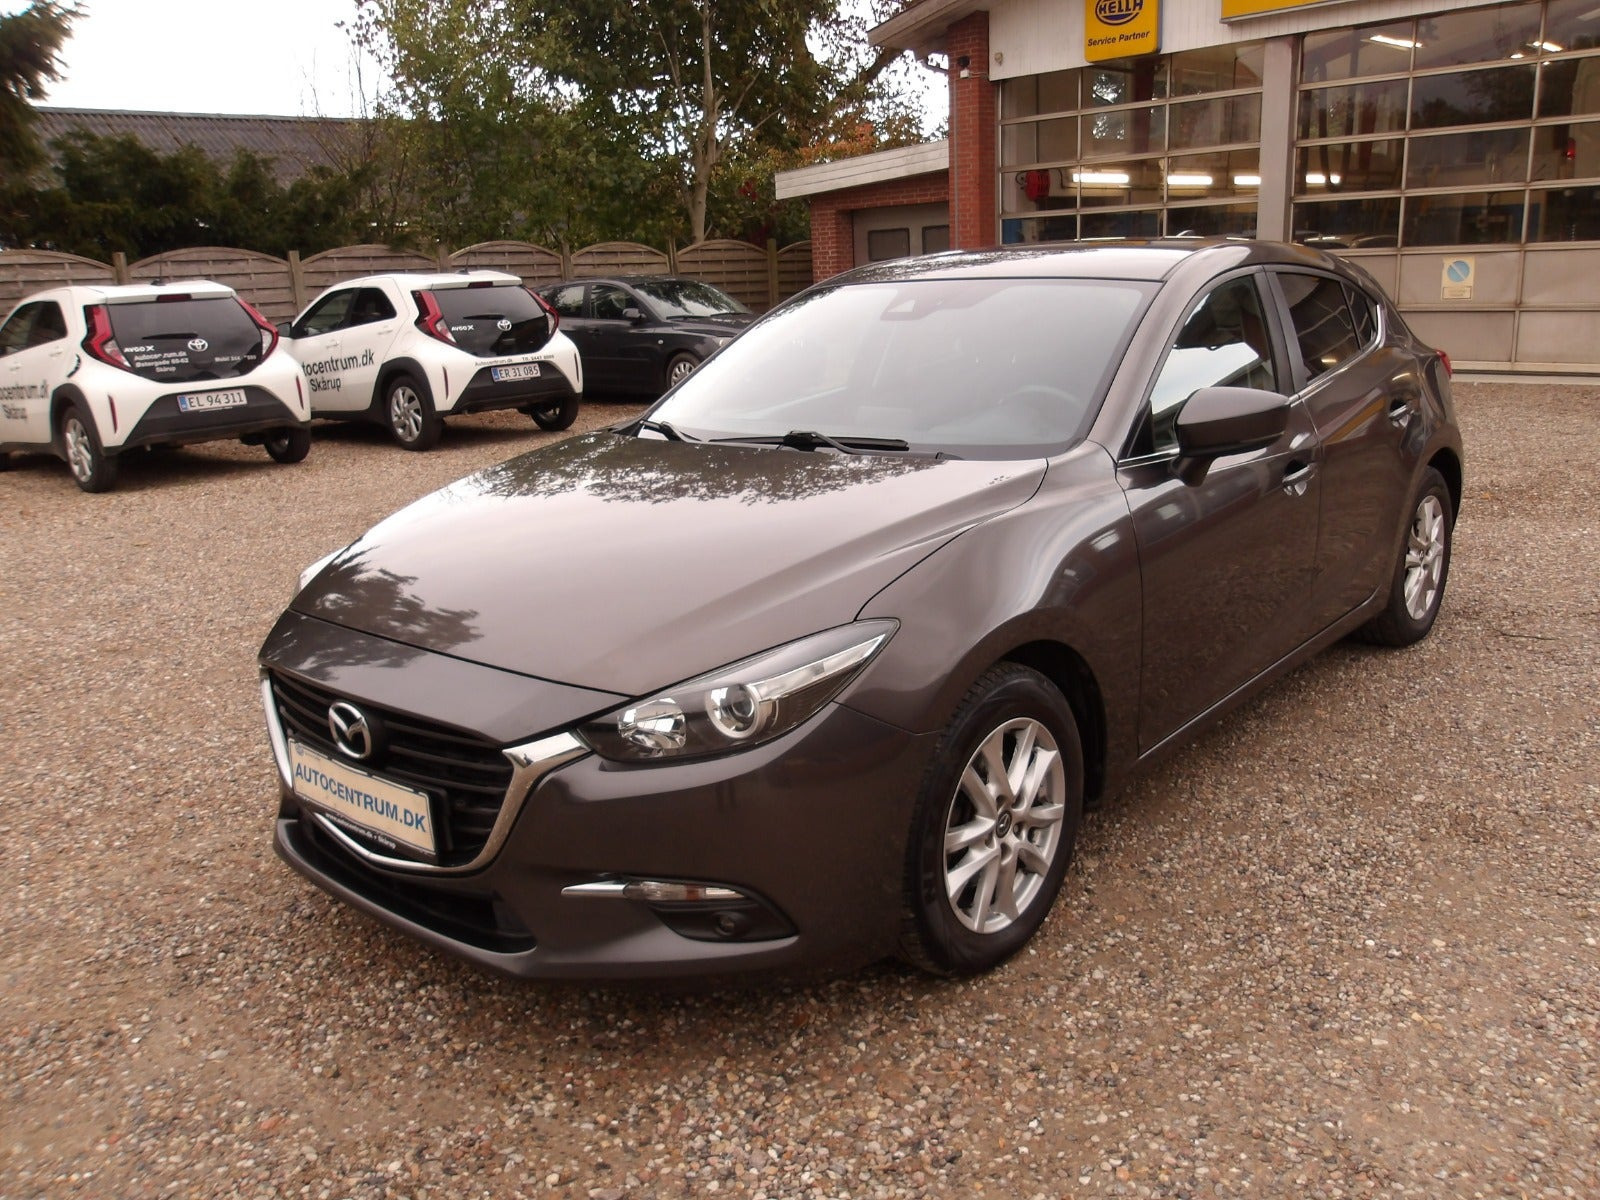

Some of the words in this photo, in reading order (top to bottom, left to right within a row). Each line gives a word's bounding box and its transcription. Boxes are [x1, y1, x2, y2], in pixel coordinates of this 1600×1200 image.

[1087, 36, 1117, 47] Service
[1118, 30, 1151, 42] Partner
[499, 369, 511, 379] ER
[511, 368, 522, 377] 31
[523, 366, 539, 376] 085
[309, 376, 342, 393] Skårup
[188, 396, 204, 408] EL
[295, 763, 427, 832] AUTOCENTRUM.DK
